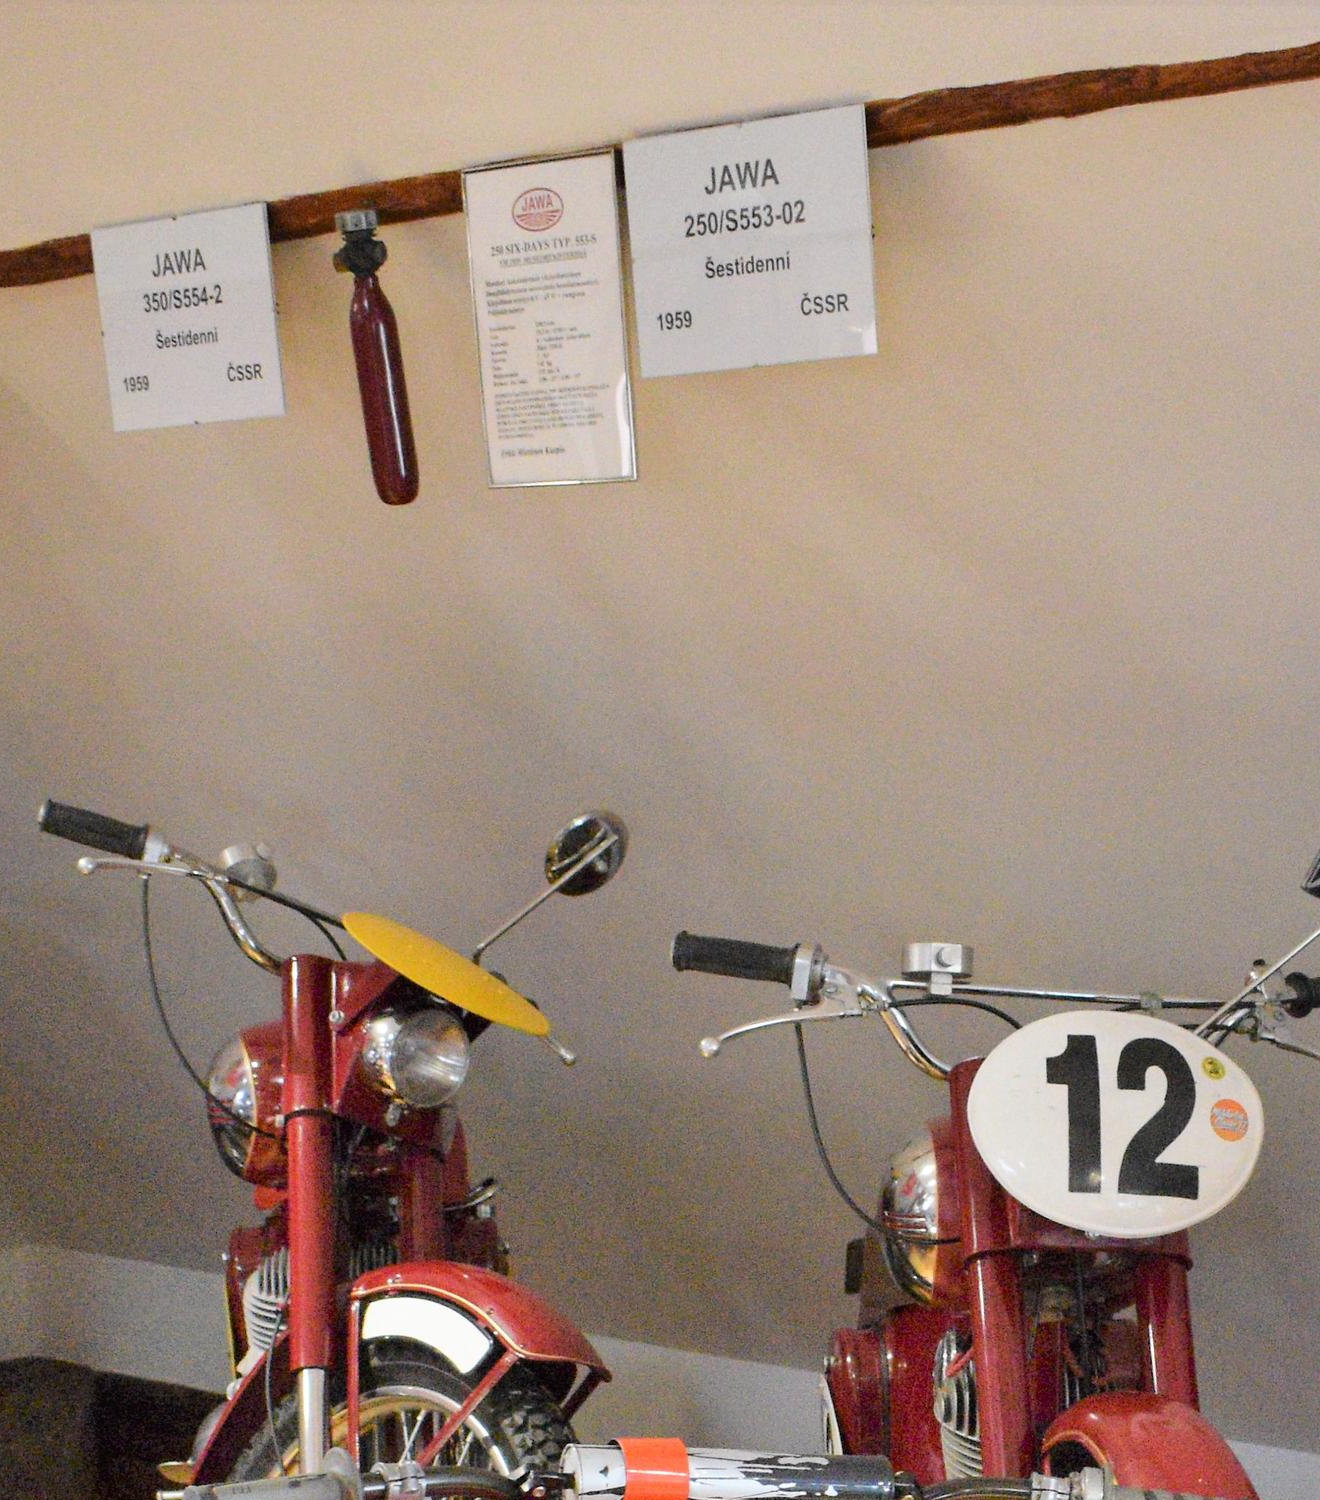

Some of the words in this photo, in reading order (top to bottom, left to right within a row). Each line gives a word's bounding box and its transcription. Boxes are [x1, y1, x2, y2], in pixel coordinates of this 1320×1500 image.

[703, 157, 780, 197] JAWA
[521, 193, 554, 212] JAWA
[683, 199, 807, 240] 250/S553-02
[152, 248, 207, 278] JAWA
[143, 284, 223, 313] 350/S554-2
[799, 292, 850, 317] ČSSR
[656, 309, 693, 332] 1959
[122, 375, 150, 392] 1959
[226, 362, 263, 382] ČSSR
[1045, 1034, 1200, 1201] 12
